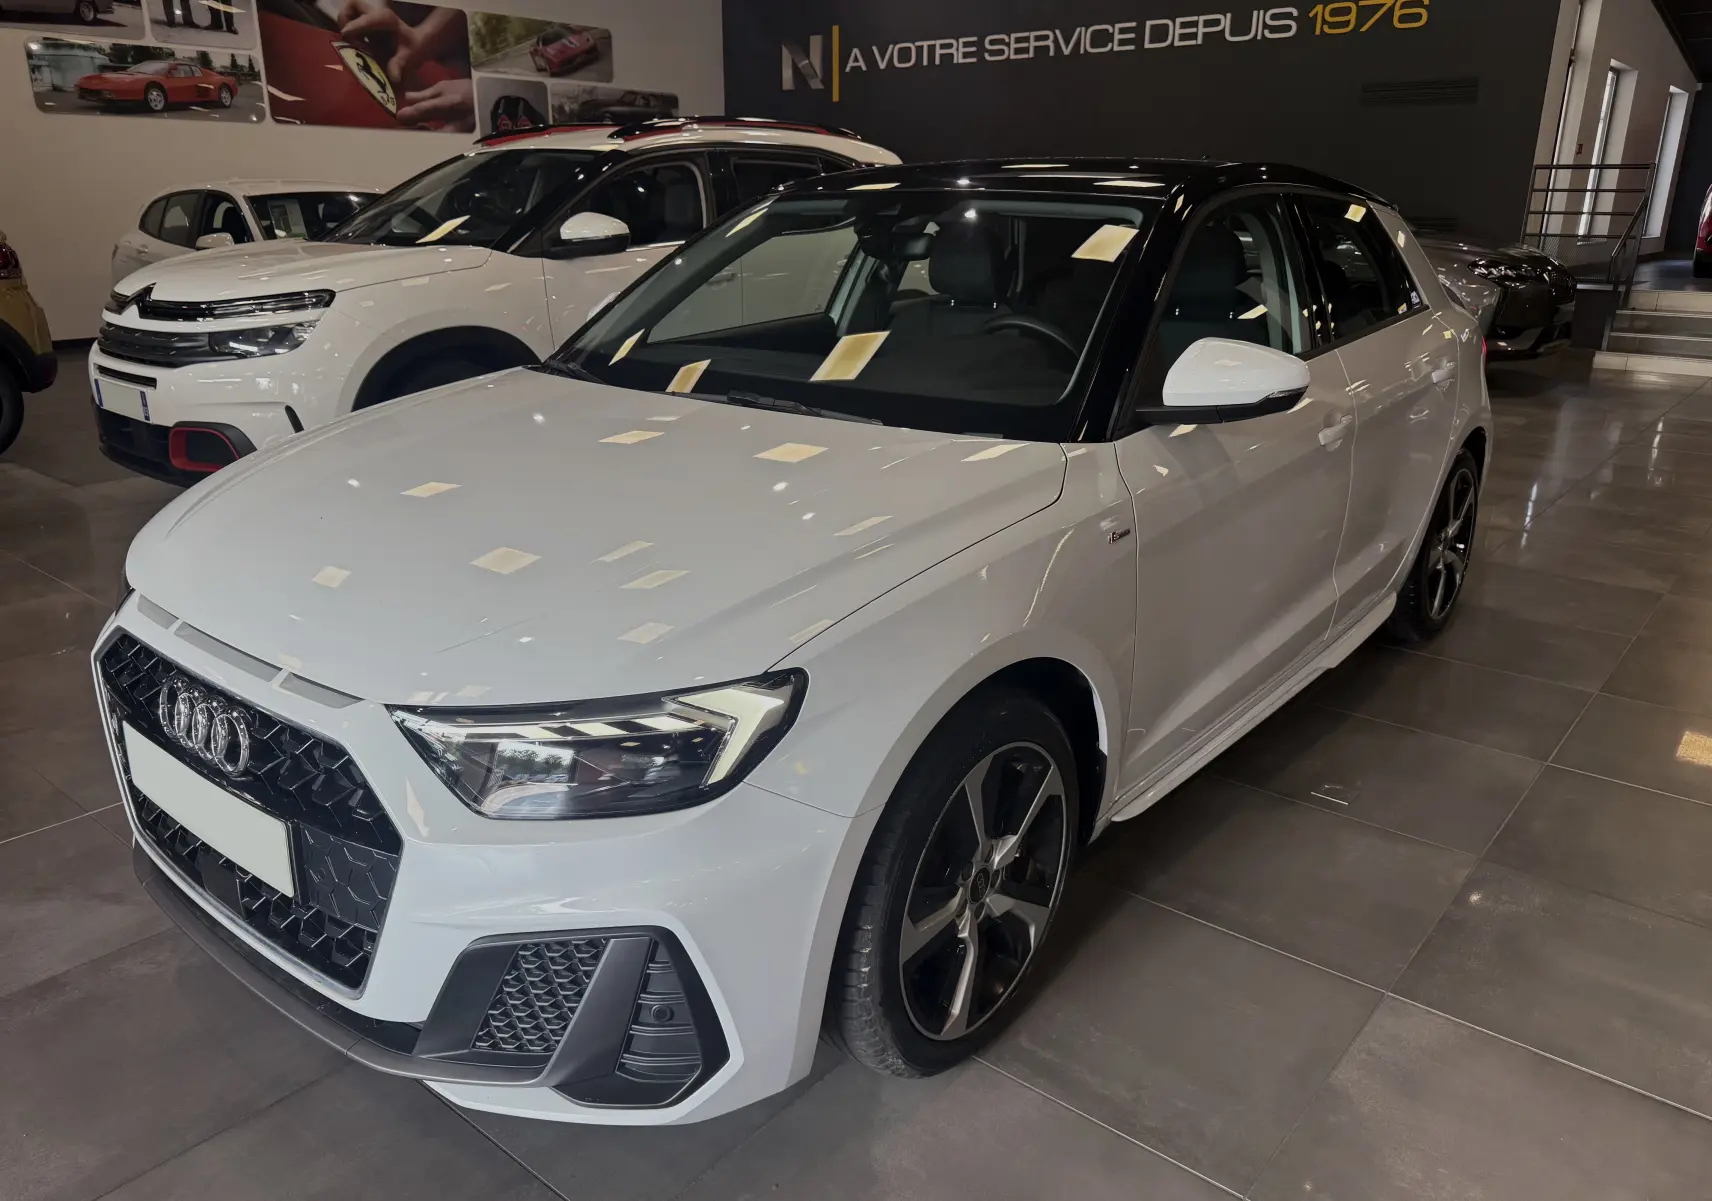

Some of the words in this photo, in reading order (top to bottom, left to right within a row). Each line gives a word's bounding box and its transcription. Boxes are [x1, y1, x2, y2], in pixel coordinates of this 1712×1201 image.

[845, 48, 867, 73] A
[872, 36, 978, 70] VOTRE
[984, 22, 1137, 62] SERVICE
[1144, 7, 1299, 49] DEPUIS
[1308, 0, 1430, 36] 1976
